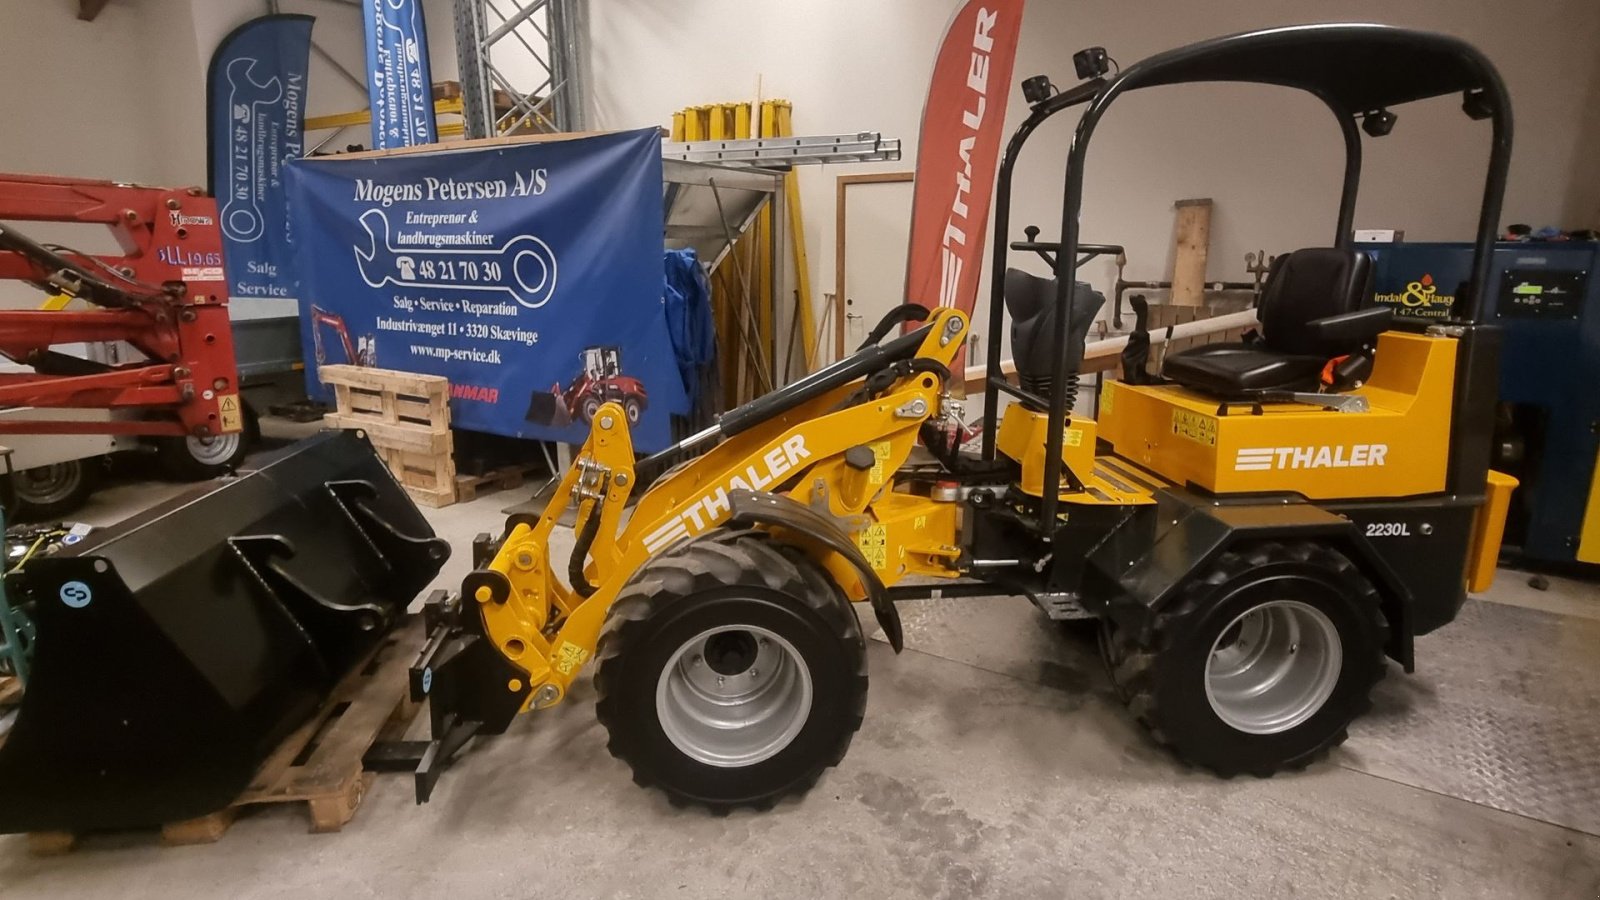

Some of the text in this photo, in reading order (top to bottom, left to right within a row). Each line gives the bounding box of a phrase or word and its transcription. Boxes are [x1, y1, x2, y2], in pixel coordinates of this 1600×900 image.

[283, 73, 302, 137] Mogens
[235, 125, 248, 200] 48 21 70 30
[271, 179, 280, 188] &
[354, 168, 548, 207] Mogens Petersen A/S
[468, 210, 479, 224] &
[397, 231, 494, 248] landbrugsmaskiner
[247, 261, 277, 277] Salg
[419, 260, 502, 281] 48 21 70 30
[237, 281, 287, 296] Service
[393, 295, 517, 317] Salg Service Reparation
[376, 316, 538, 346] Industrivænget 11 3320 Skævinge
[410, 345, 501, 364] www.mp-service.dk
[1274, 444, 1388, 469] THALER
[1366, 522, 1410, 537] 2230L
